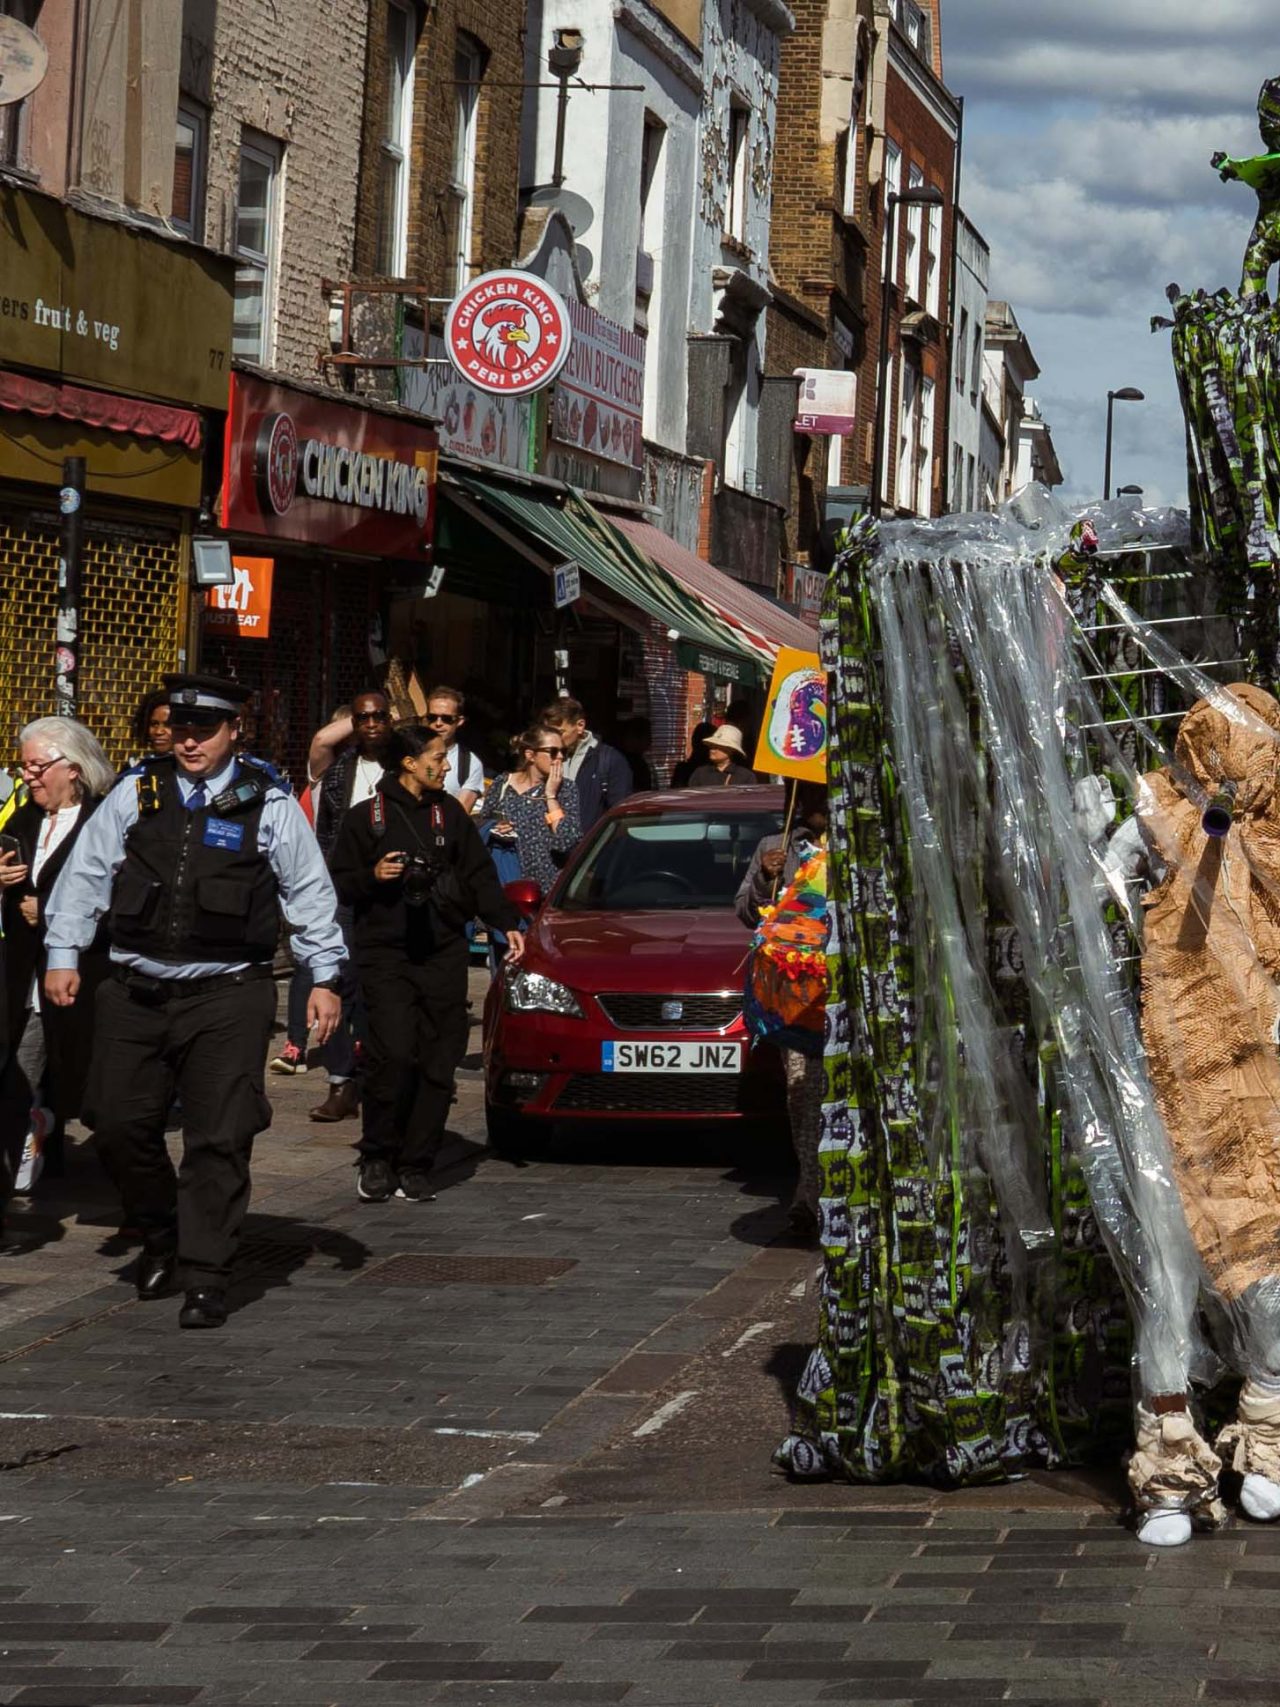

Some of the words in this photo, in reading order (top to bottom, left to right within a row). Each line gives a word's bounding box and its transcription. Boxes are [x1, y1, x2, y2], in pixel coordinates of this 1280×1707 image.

[458, 283, 519, 328] CHICKEN
[523, 288, 554, 325] KING
[34, 298, 72, 332] fruit
[76, 309, 88, 336] &
[94, 320, 120, 351] veg
[209, 349, 225, 371] 77
[467, 359, 505, 385] PERI
[511, 356, 548, 384] PERI
[595, 350, 643, 408] BUTCHERS
[303, 439, 384, 510] CHICKEN
[384, 460, 429, 527] KING
[237, 614, 261, 627] EAT
[618, 1045, 681, 1068] SW62
[689, 1045, 737, 1068] JNZ
